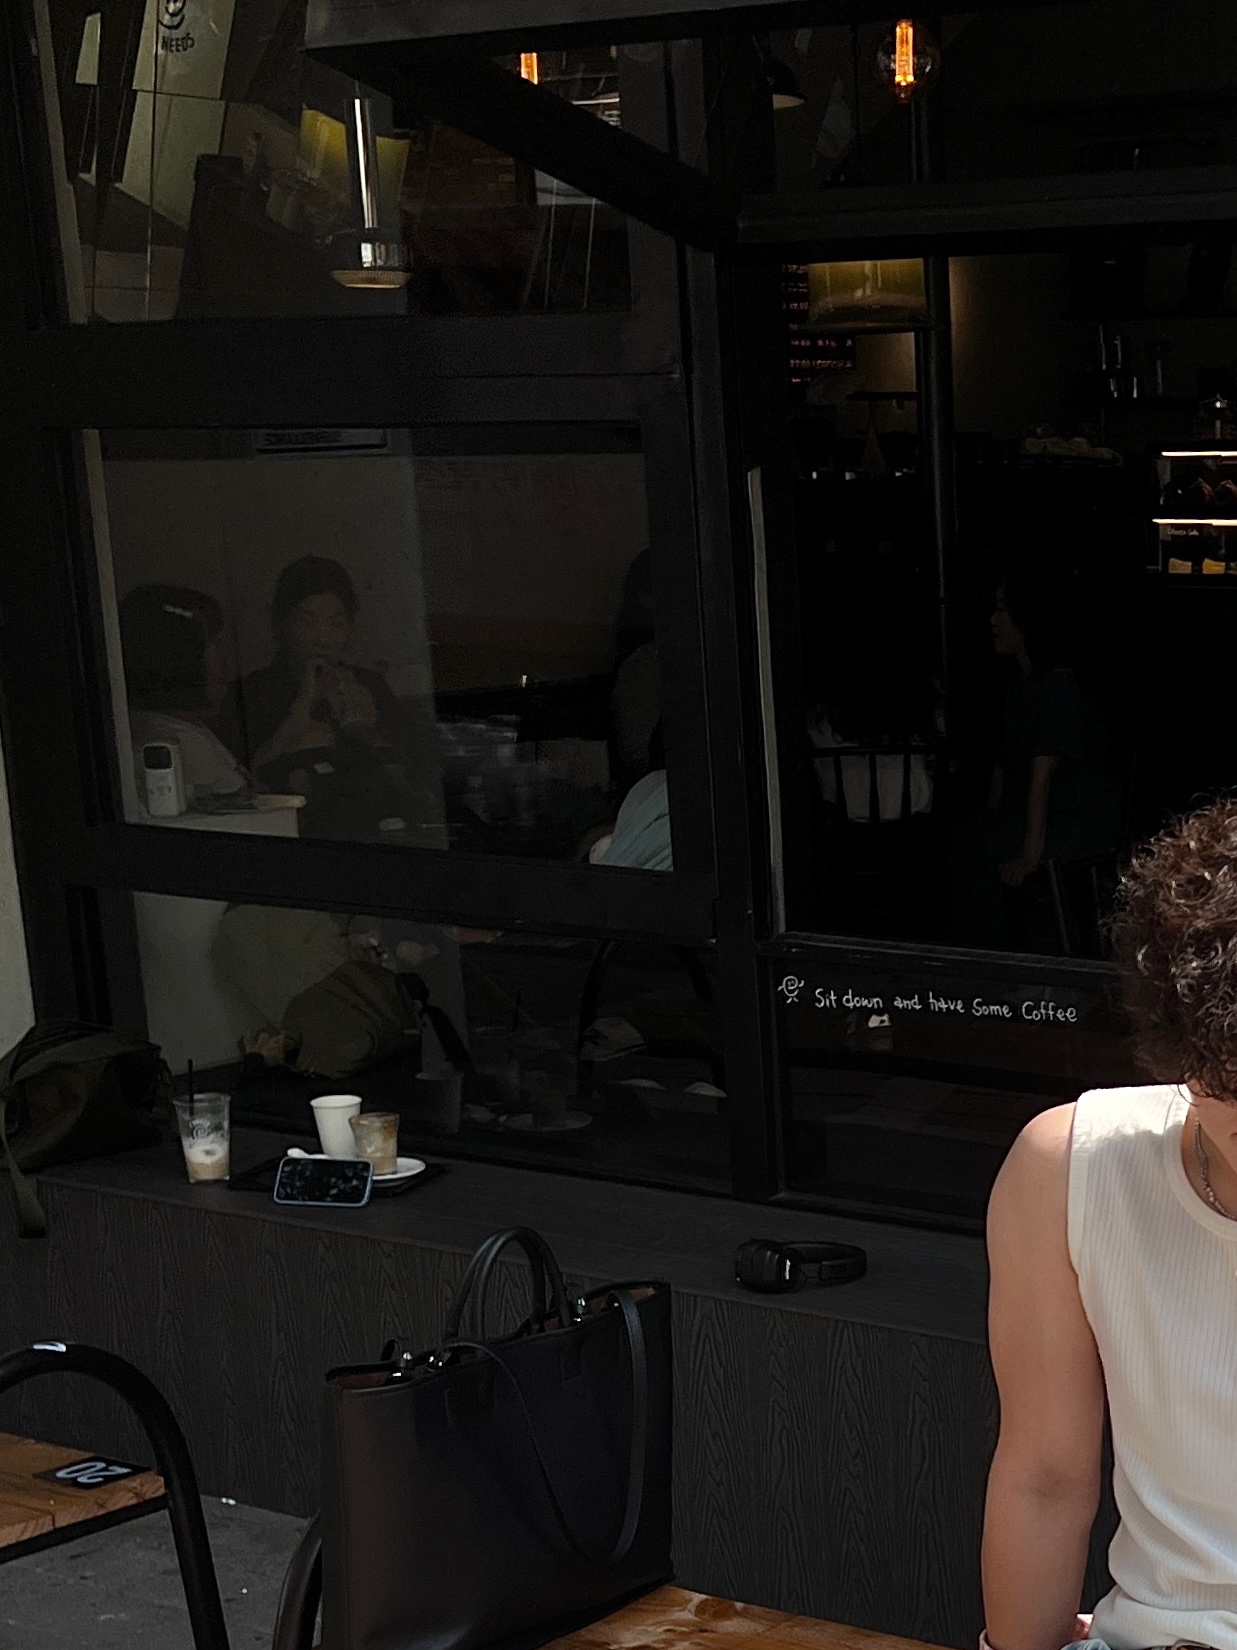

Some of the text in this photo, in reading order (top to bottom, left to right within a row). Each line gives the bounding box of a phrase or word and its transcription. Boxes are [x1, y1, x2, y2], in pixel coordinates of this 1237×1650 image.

[815, 988, 837, 1008] Sit
[842, 988, 883, 1009] down
[893, 996, 922, 1010] and
[972, 998, 1012, 1018] Some
[1022, 1001, 1077, 1022] Coffee
[56, 1462, 132, 1483] 20
